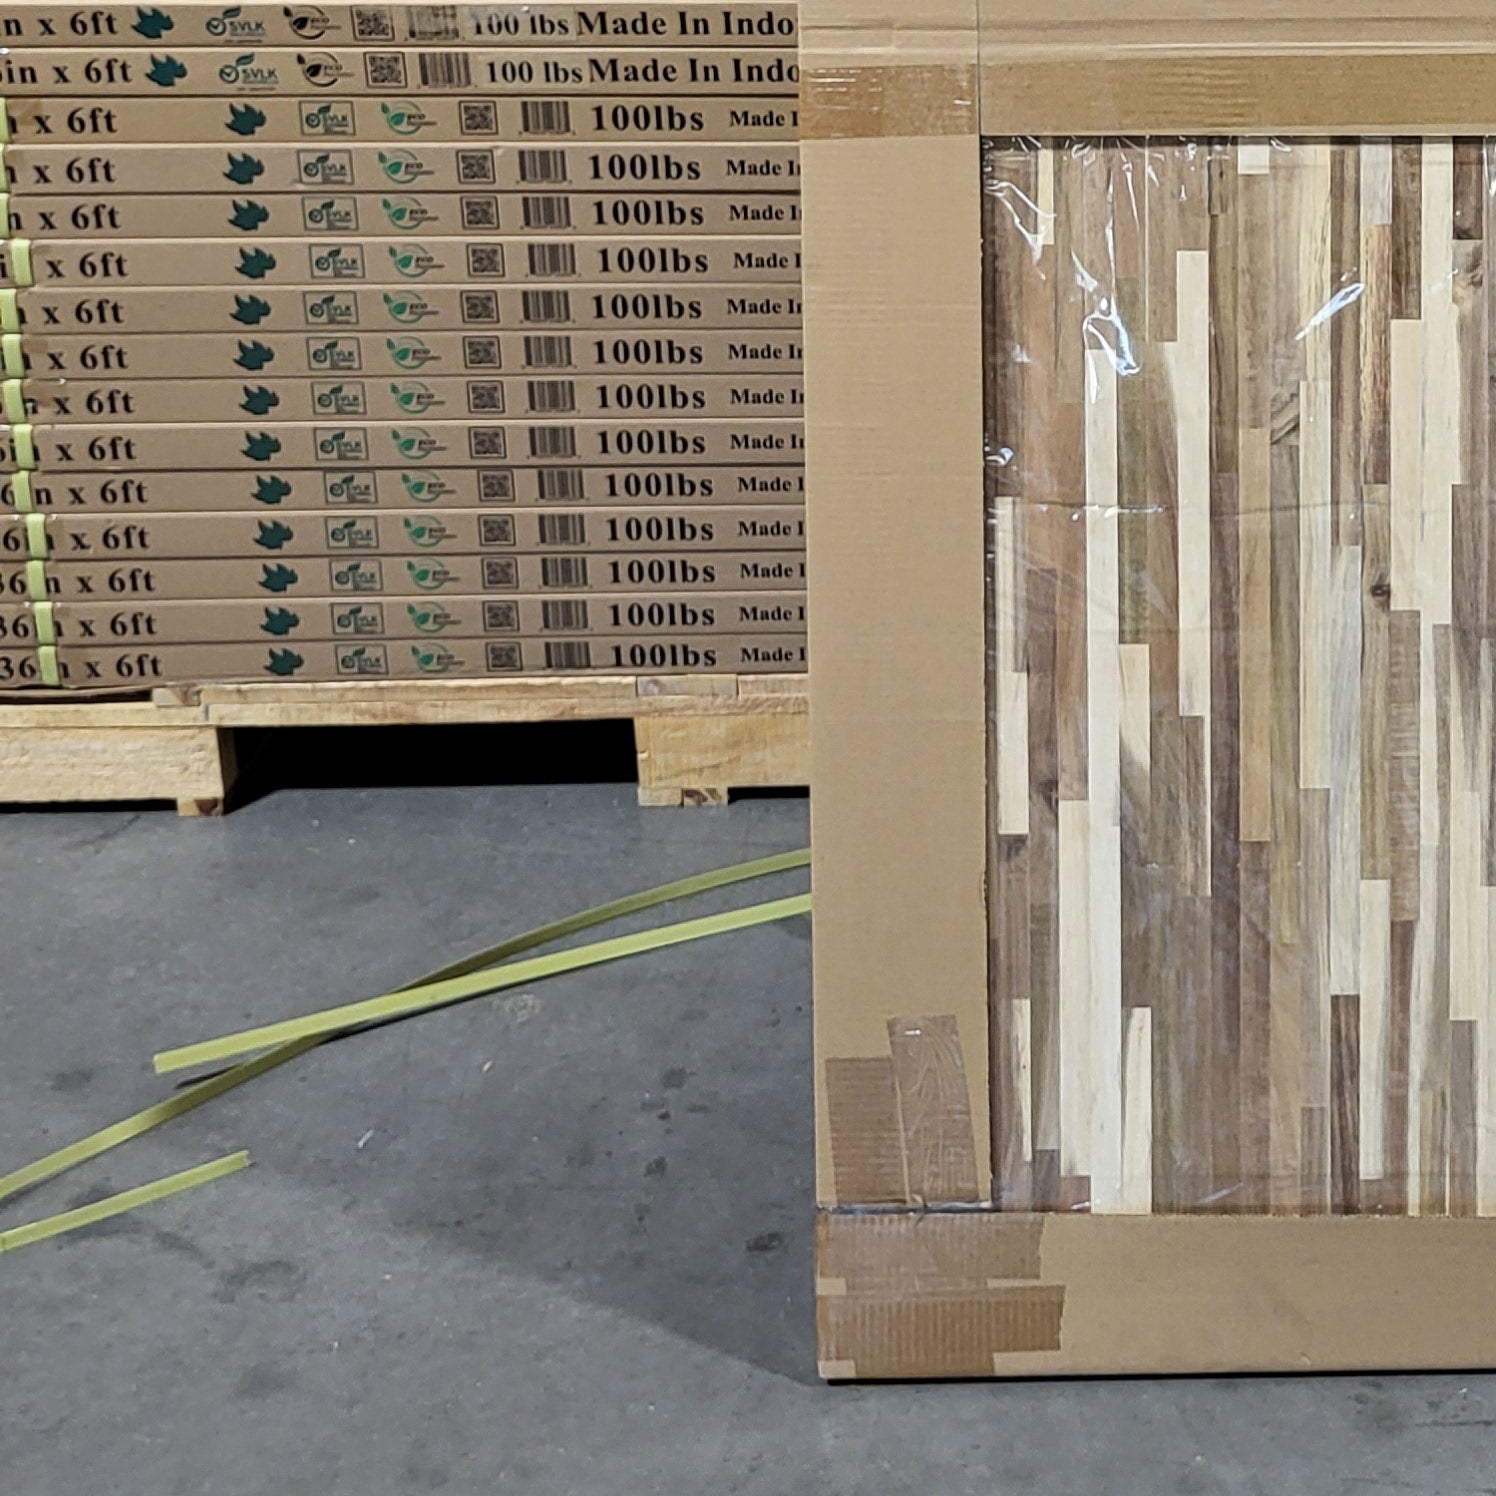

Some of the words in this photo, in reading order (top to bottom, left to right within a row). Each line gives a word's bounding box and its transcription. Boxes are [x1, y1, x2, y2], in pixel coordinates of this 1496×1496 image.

[38, 18, 56, 36] x
[69, 11, 117, 36] 6ft
[229, 20, 265, 32] SVLK
[475, 15, 520, 35] 100
[530, 13, 569, 35] lbs
[577, 11, 666, 36] Made
[678, 11, 710, 35] In
[52, 66, 70, 84] x
[84, 58, 130, 83] 6ft
[241, 69, 279, 81] SVLK
[488, 61, 533, 83] 100
[543, 61, 583, 83] lbs
[589, 58, 677, 83] Made
[689, 58, 720, 83] In
[67, 107, 117, 134] 6ft
[593, 105, 704, 131] 100lbs
[730, 110, 785, 127] Made
[65, 157, 117, 183] 6ft
[590, 154, 701, 180] 100lbs
[71, 203, 119, 230] 6ft
[594, 200, 704, 226] 100lbs
[79, 252, 126, 278] 6ft
[599, 247, 708, 273] 100lbs
[734, 252, 789, 269] Made
[75, 298, 122, 324] 6ft
[593, 294, 702, 319] 100lbs
[79, 344, 127, 370] 6ft
[595, 339, 703, 364] 100lbs
[85, 389, 133, 414] 6ft
[597, 384, 706, 409] 100lbs
[731, 388, 785, 404] Made
[88, 436, 134, 461] 6ft
[598, 429, 706, 454] 100lbs
[100, 479, 146, 504] 6ft
[607, 472, 713, 497] 100lbs
[102, 525, 148, 550] 6ft
[607, 517, 714, 542] 100lbs
[738, 520, 792, 537] Made
[108, 568, 153, 593] 6ft
[610, 559, 716, 584] 100lbs
[110, 611, 155, 636] 6ft
[610, 603, 715, 627] 100lbs
[0, 655, 71, 682] 36n
[84, 661, 101, 679] x
[115, 653, 160, 677] 6ft
[612, 644, 717, 668] 100lbs
[741, 647, 793, 662] Made
